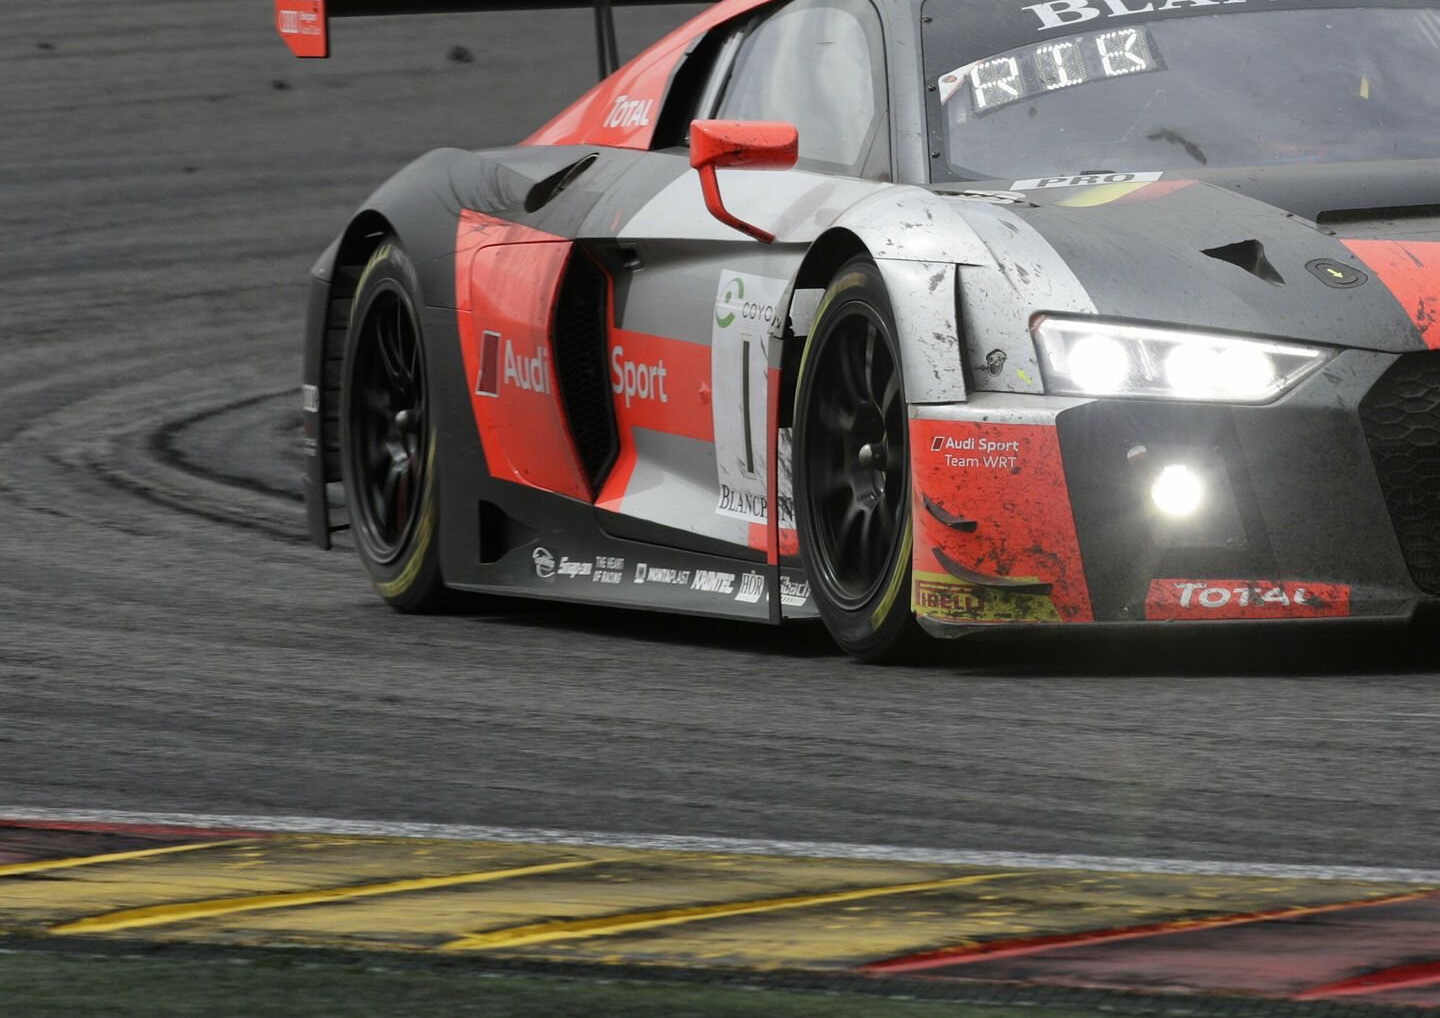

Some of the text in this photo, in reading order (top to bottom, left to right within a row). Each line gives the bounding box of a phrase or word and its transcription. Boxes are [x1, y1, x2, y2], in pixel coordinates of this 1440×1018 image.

[603, 95, 654, 128] TOTAL
[1036, 173, 1135, 188] PRO
[741, 301, 777, 323] COYO
[503, 340, 669, 408] Audi Sport
[945, 436, 1020, 454] Audi Sport
[944, 454, 1017, 469] Team WRT
[1174, 582, 1312, 609] TOTAL
